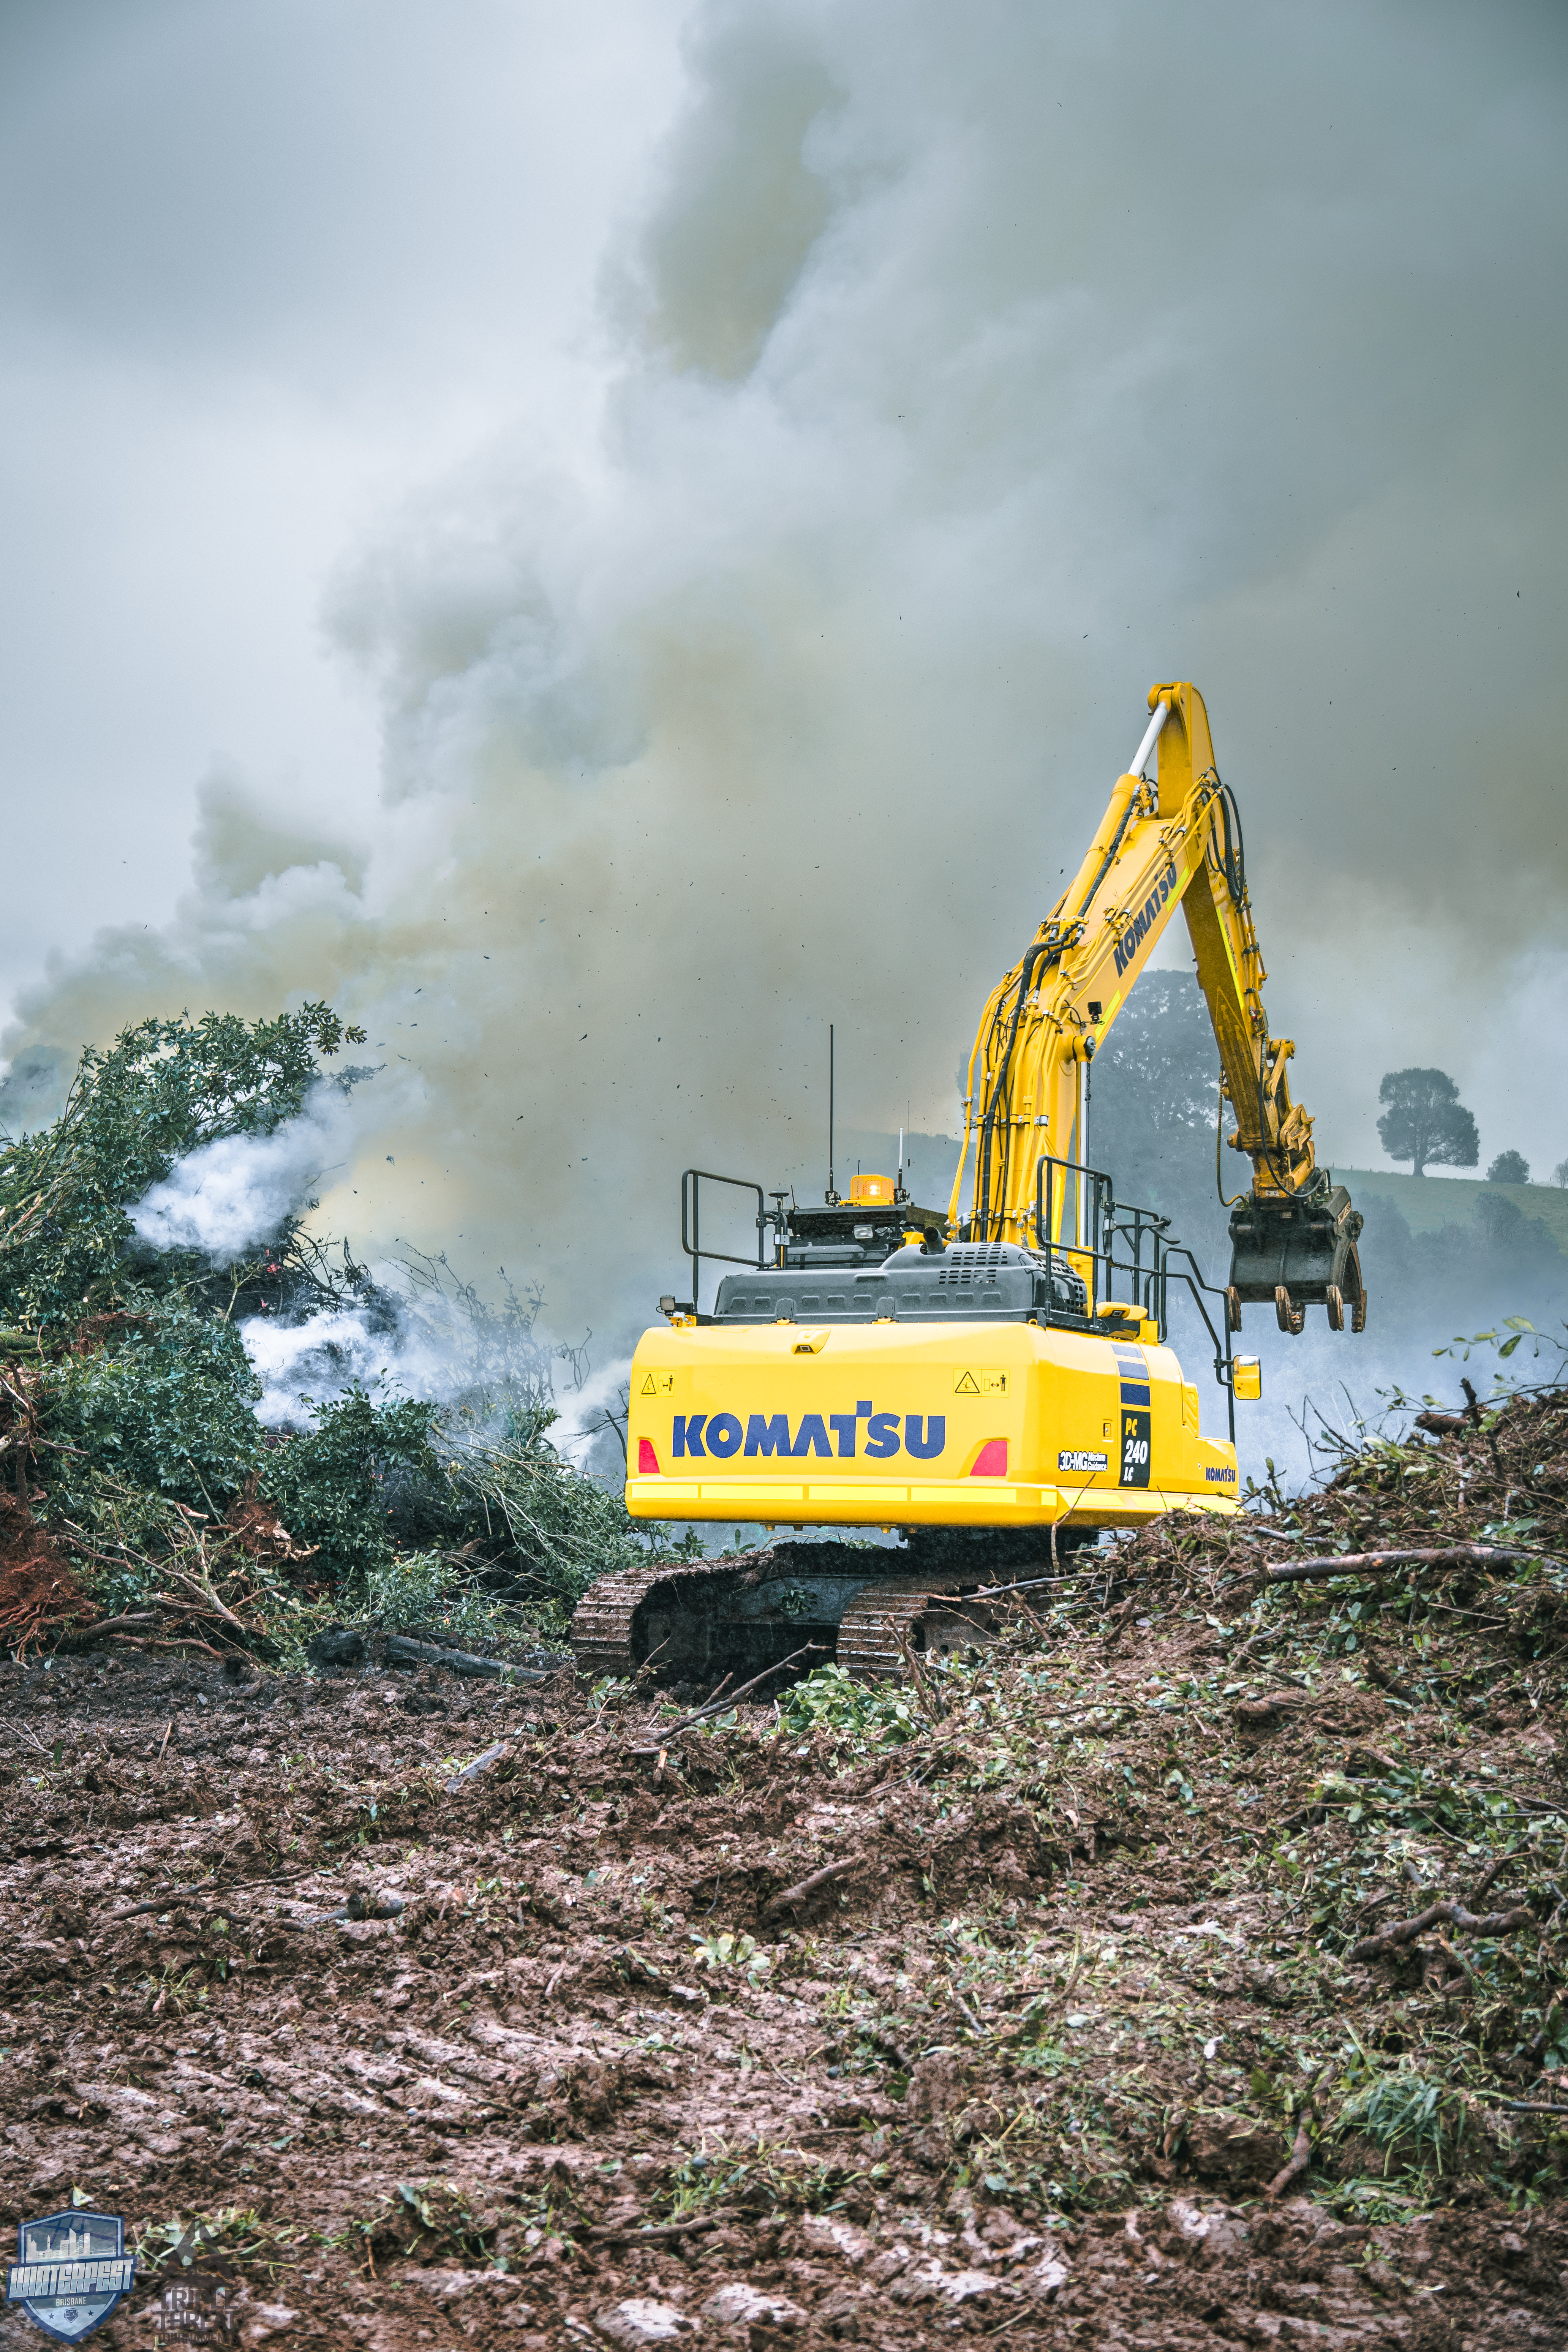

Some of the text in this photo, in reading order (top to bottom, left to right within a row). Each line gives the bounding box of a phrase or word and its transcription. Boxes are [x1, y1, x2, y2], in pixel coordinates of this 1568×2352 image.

[1113, 861, 1177, 978] KOMATSU
[673, 1401, 945, 1459] KOMATSU
[1125, 1418, 1138, 1436] PC
[1088, 1451, 1106, 1462] Machine
[1124, 1439, 1148, 1464] 240
[1059, 1451, 1088, 1471] 3D-MG
[1087, 1461, 1107, 1471] Guidance
[1123, 1467, 1134, 1481] LC
[1206, 1465, 1236, 1483] KOMATSU
